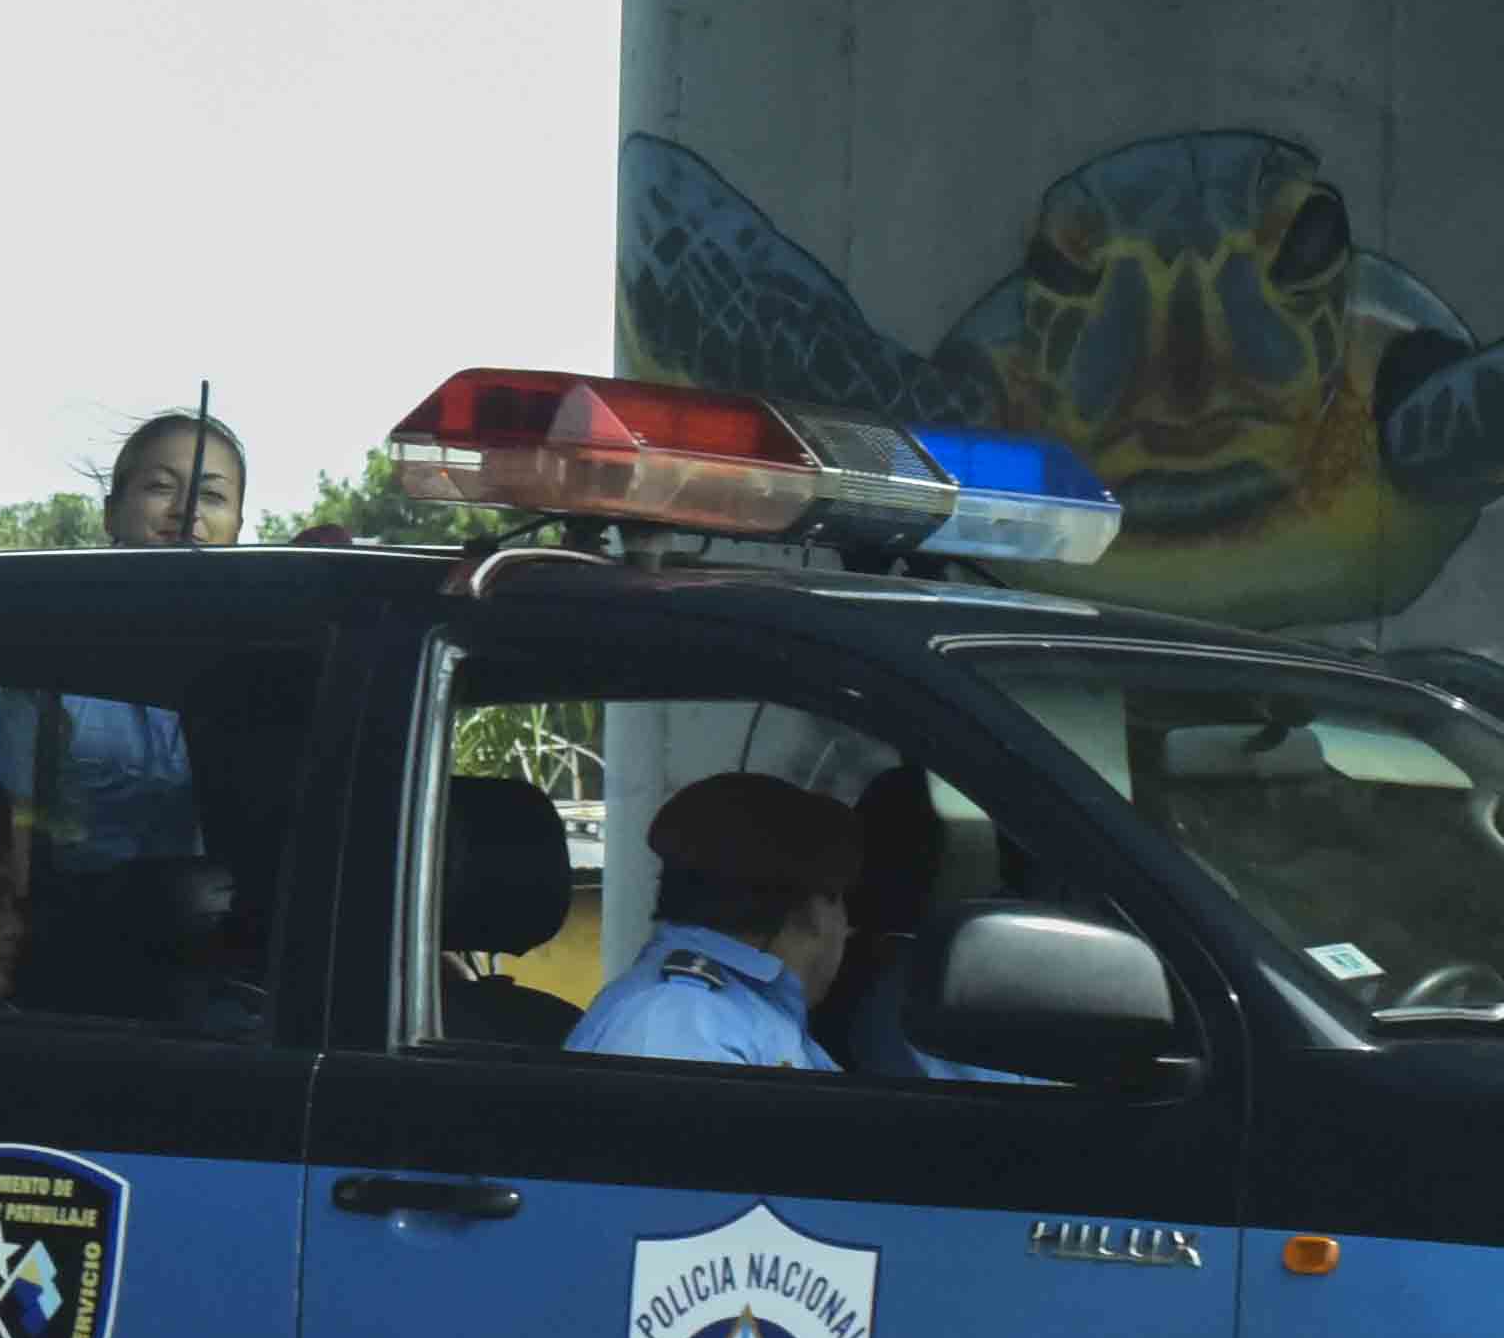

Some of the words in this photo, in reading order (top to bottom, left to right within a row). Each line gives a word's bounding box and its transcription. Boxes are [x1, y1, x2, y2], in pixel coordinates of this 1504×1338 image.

[52, 1178, 75, 1197] DE
[5, 1202, 98, 1228] PATRULLAJE
[1026, 1221, 1205, 1269] HILUX
